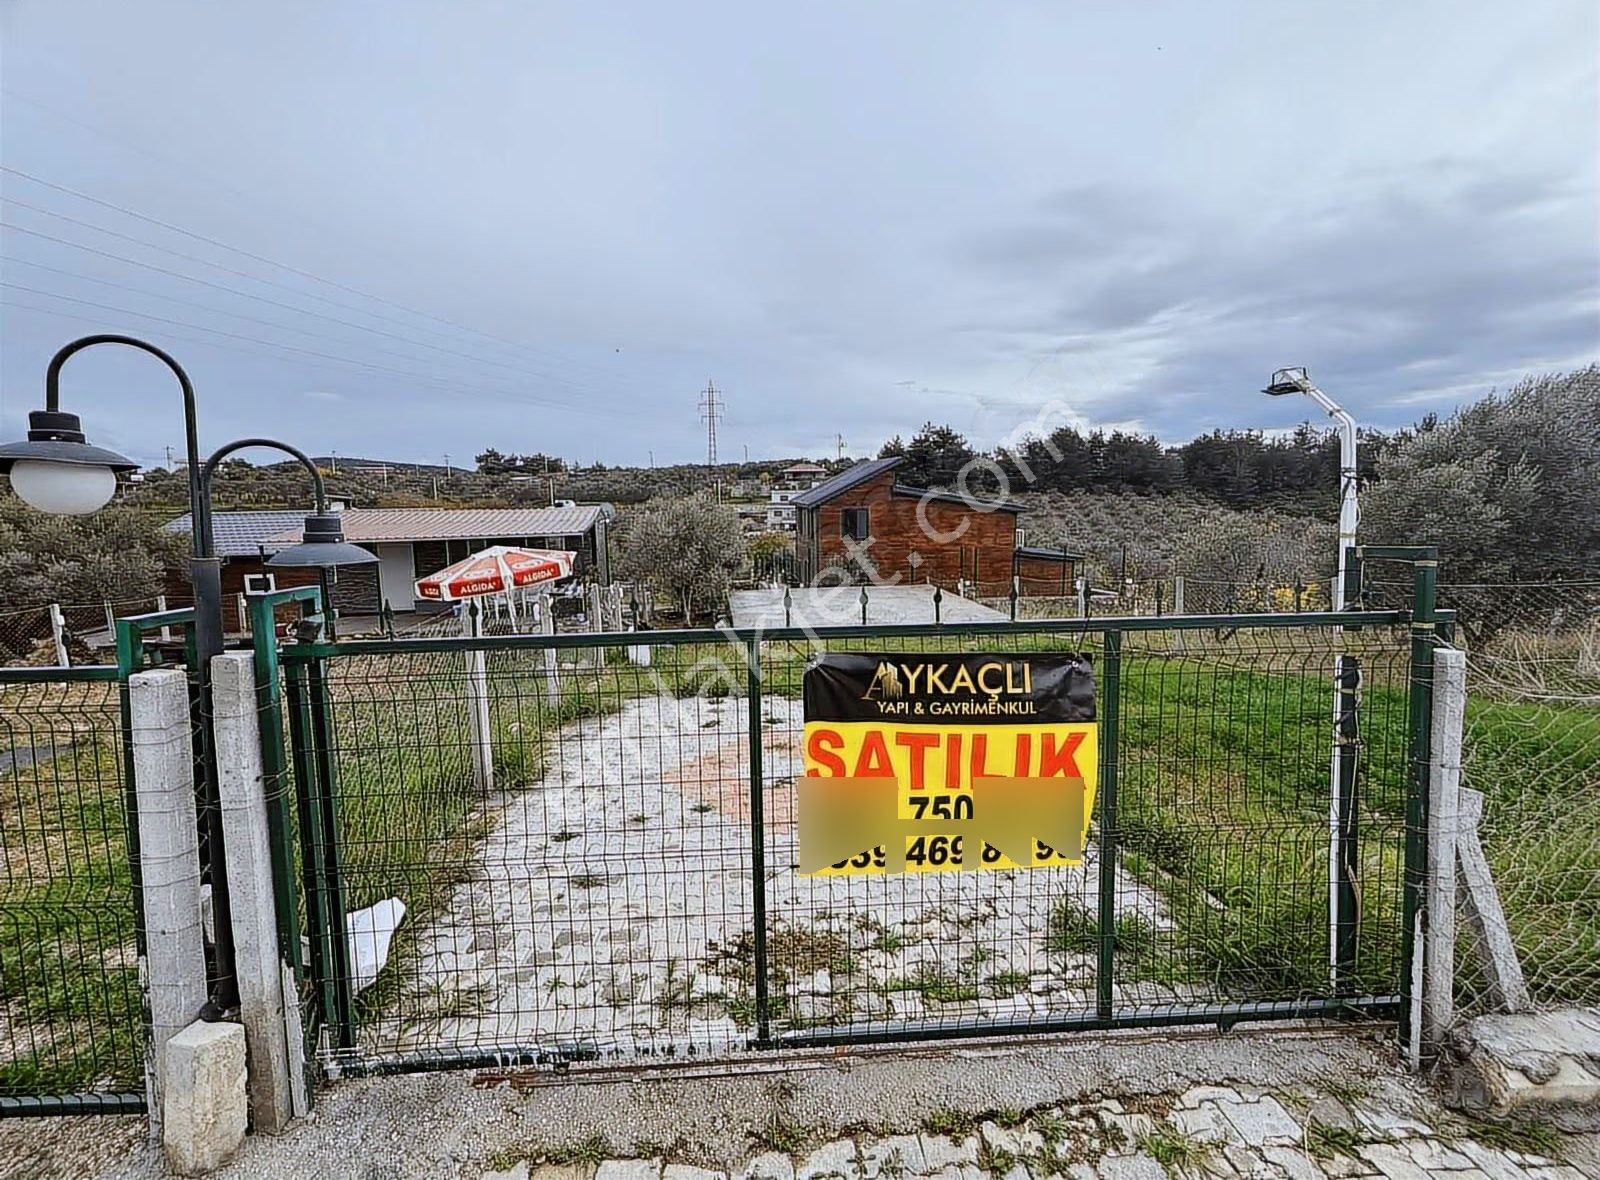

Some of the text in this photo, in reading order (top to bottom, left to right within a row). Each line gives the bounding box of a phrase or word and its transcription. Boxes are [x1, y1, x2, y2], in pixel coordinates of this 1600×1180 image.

[522, 569, 553, 584] ALGIDA
[460, 582, 496, 594] ALGIDA
[860, 661, 1032, 702] AYKAÇLI
[876, 699, 1037, 716] YAPI & GAYRİMENKUL
[806, 729, 1088, 790] SATILIK
